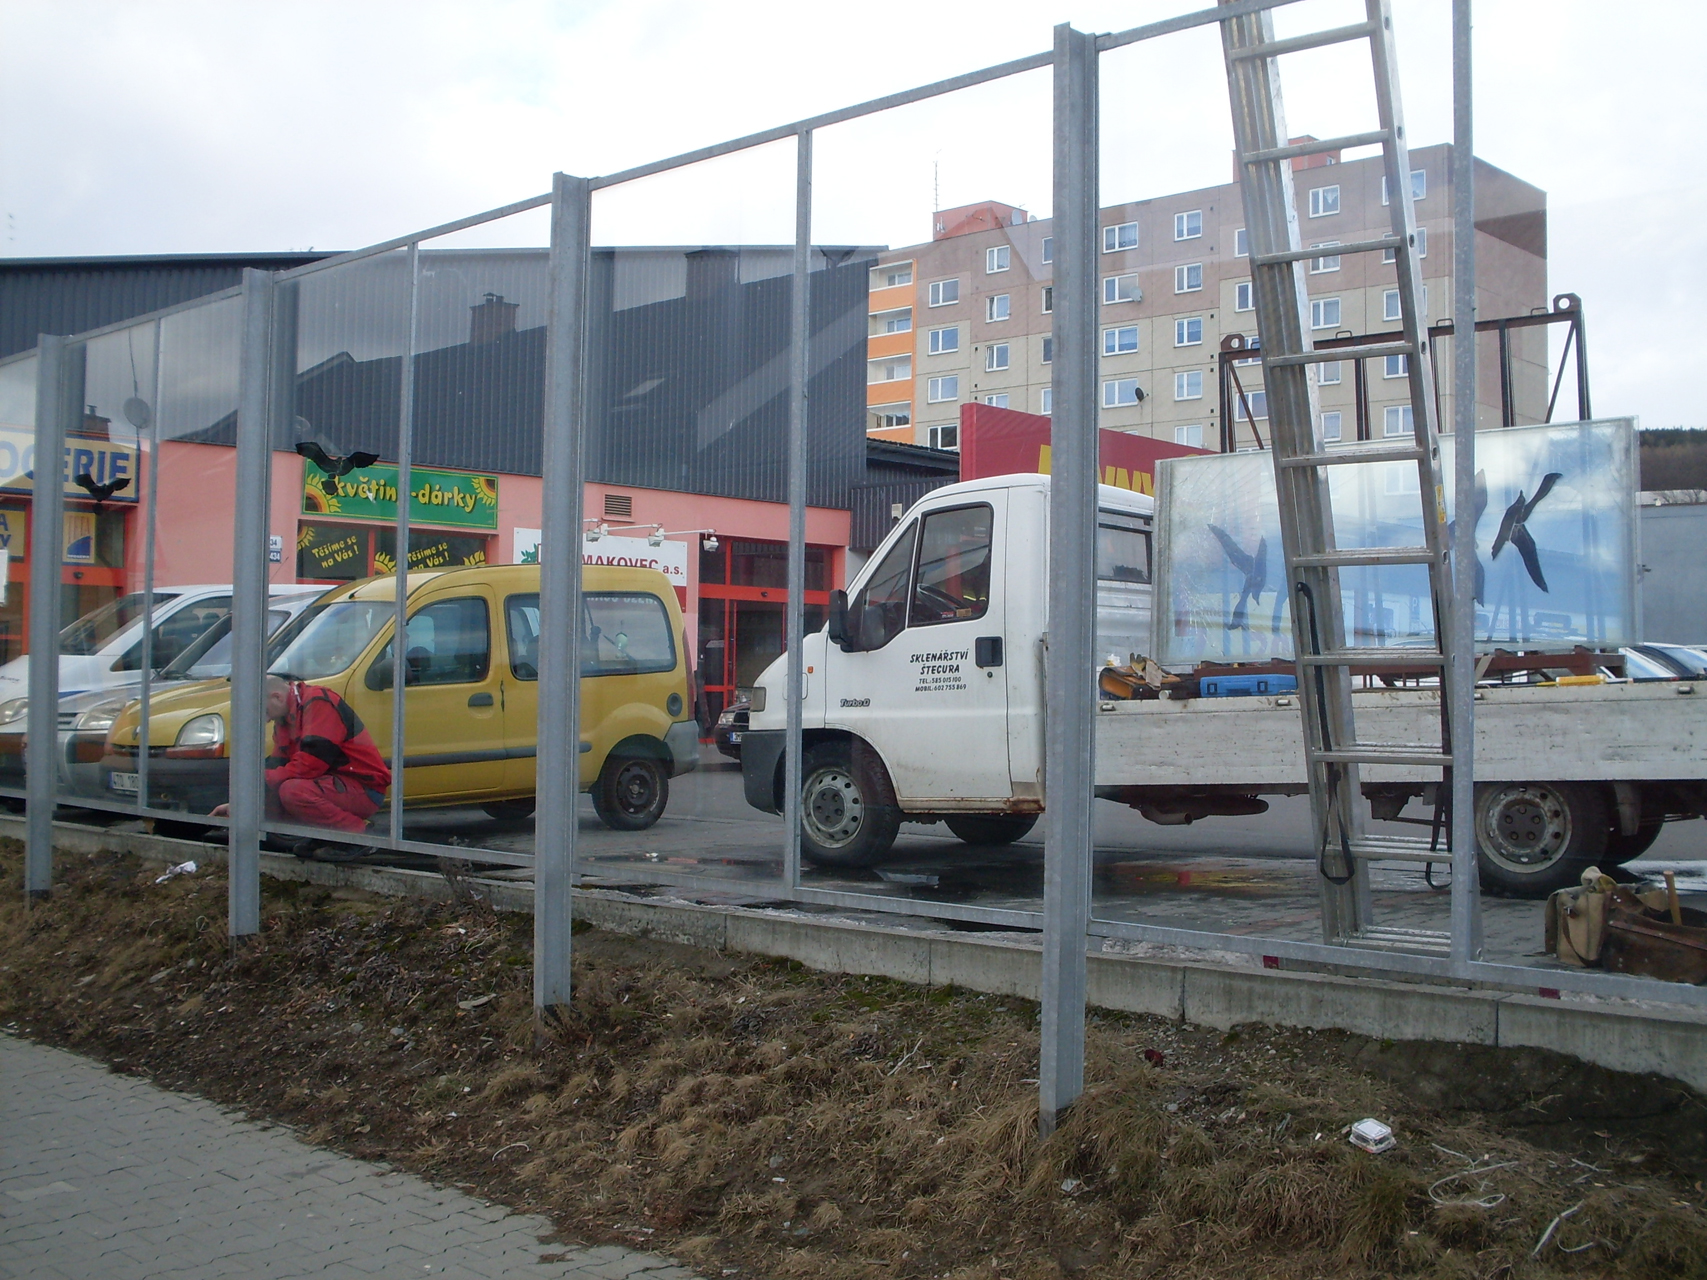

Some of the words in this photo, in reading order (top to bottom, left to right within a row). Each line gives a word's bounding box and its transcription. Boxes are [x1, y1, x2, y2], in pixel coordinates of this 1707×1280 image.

[346, 535, 357, 545] se
[438, 542, 448, 551] se
[321, 558, 334, 569] na
[334, 549, 353, 562] Vás
[426, 555, 444, 567] Vás
[662, 565, 683, 575] a.s.
[909, 648, 969, 663] SKLENÁŘSTVÍ
[920, 663, 960, 675] ŠTECURA
